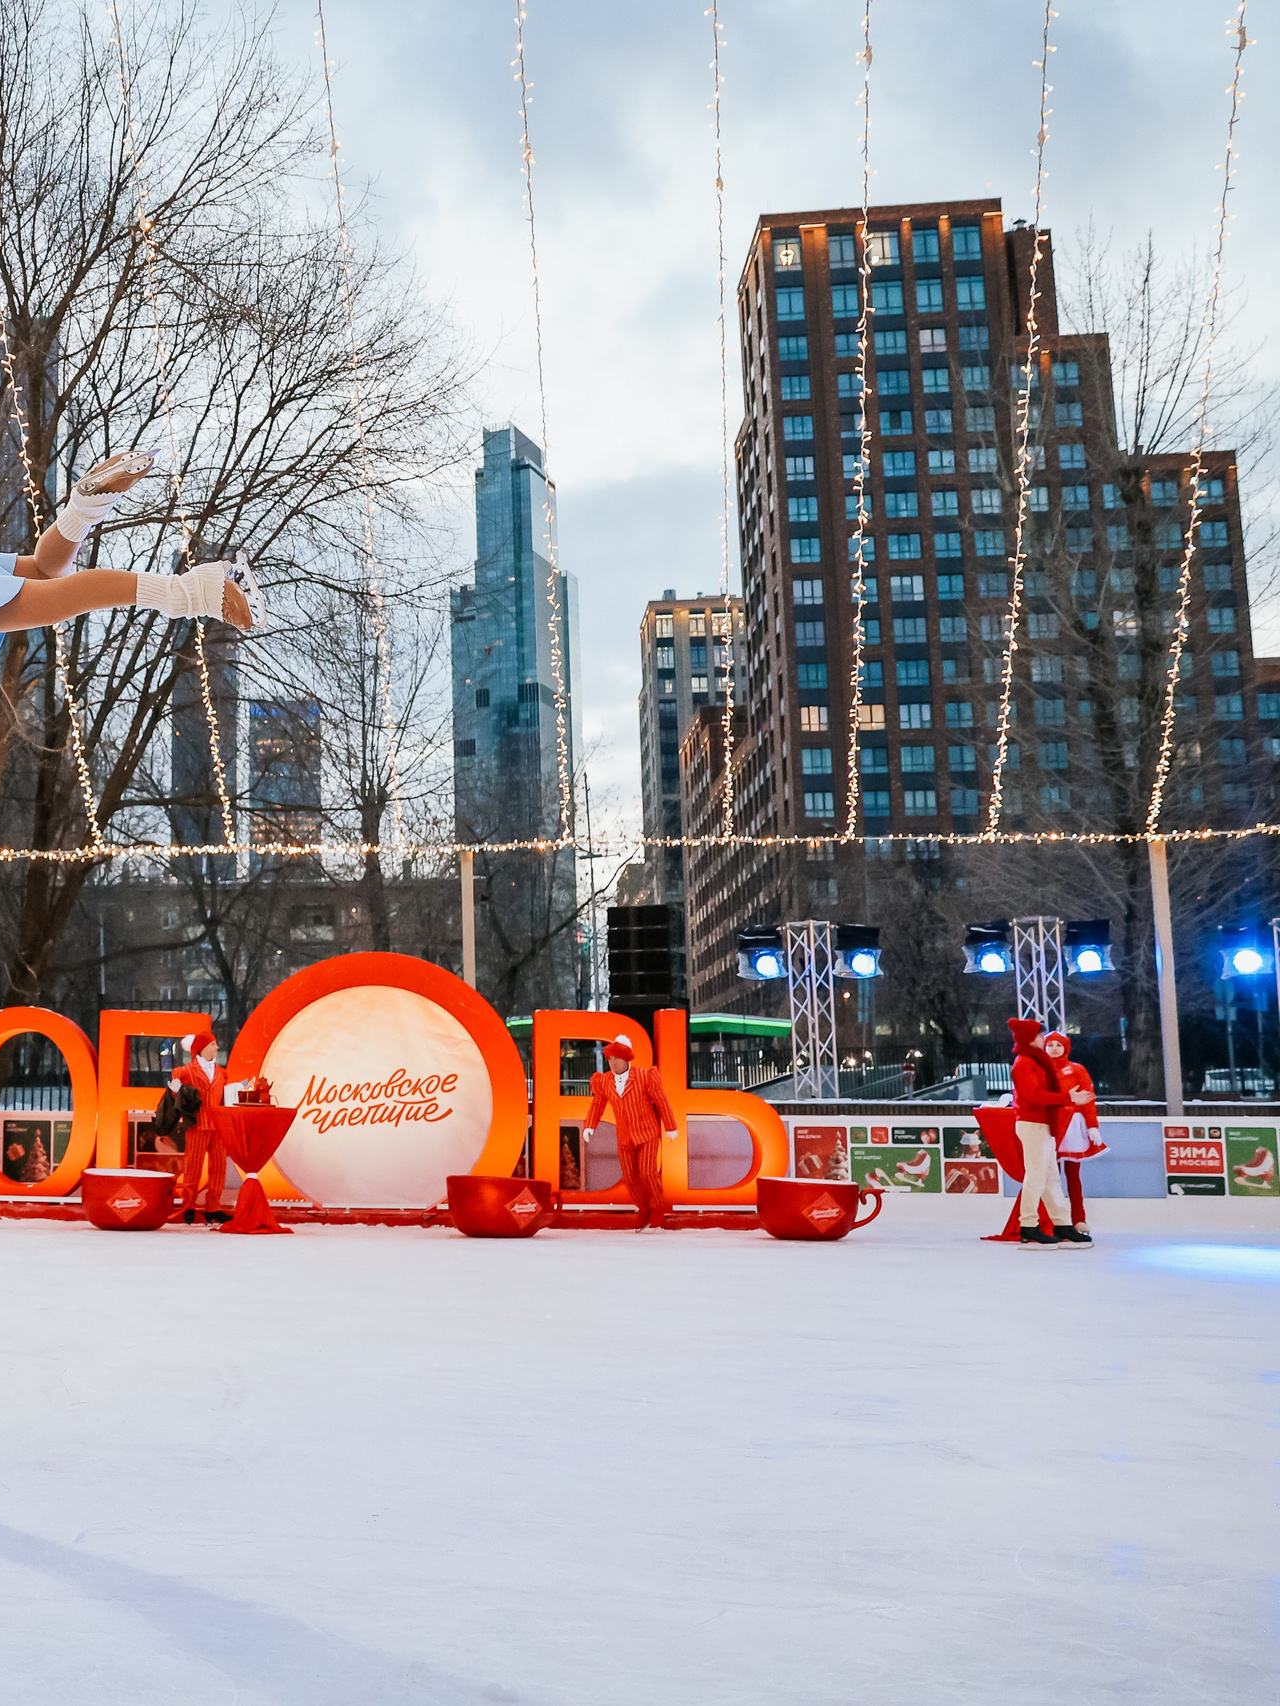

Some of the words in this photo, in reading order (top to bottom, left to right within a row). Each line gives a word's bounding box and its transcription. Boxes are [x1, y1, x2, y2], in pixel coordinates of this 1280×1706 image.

[296, 1068, 458, 1109] Московское
[1169, 1146, 1220, 1158] ЗИМА
[1179, 1159, 1220, 1167] МОСКВЕ
